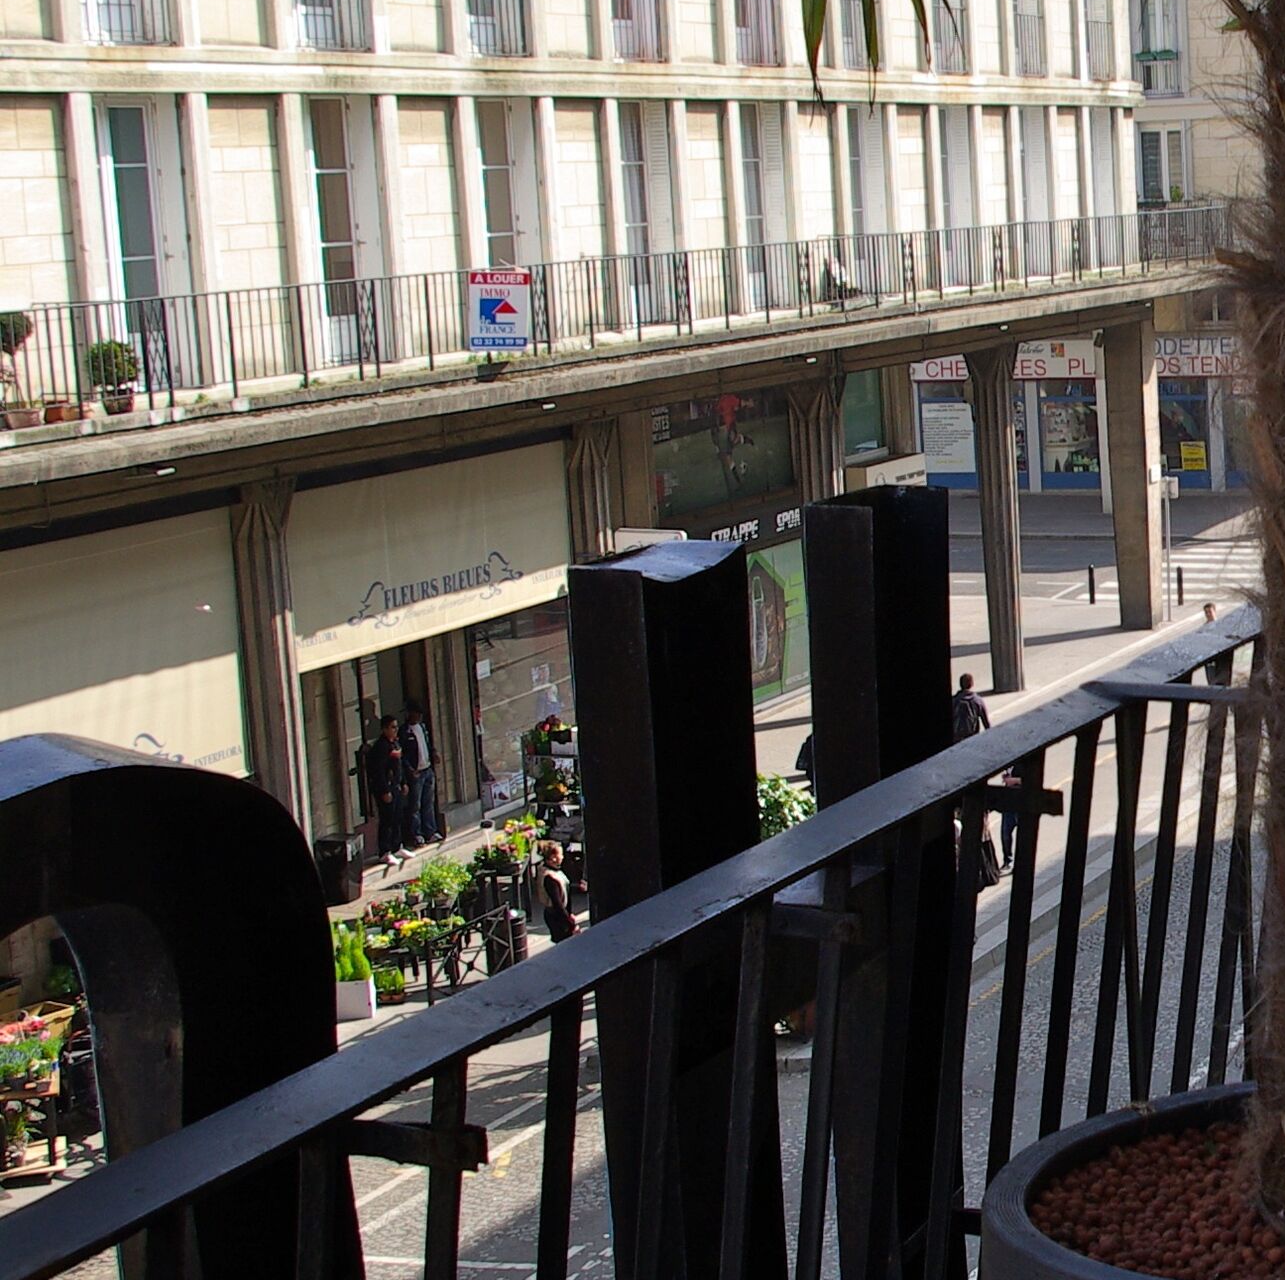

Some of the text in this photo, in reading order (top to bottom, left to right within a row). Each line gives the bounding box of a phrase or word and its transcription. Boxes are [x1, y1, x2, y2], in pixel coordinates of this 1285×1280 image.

[475, 274, 525, 283] A LOUER
[480, 288, 510, 298] IMMO
[480, 325, 516, 334] FRANCE
[1068, 358, 1097, 376] PL
[383, 563, 491, 610] FLEURS BLEUES
[194, 744, 242, 767] INTERFLORA
